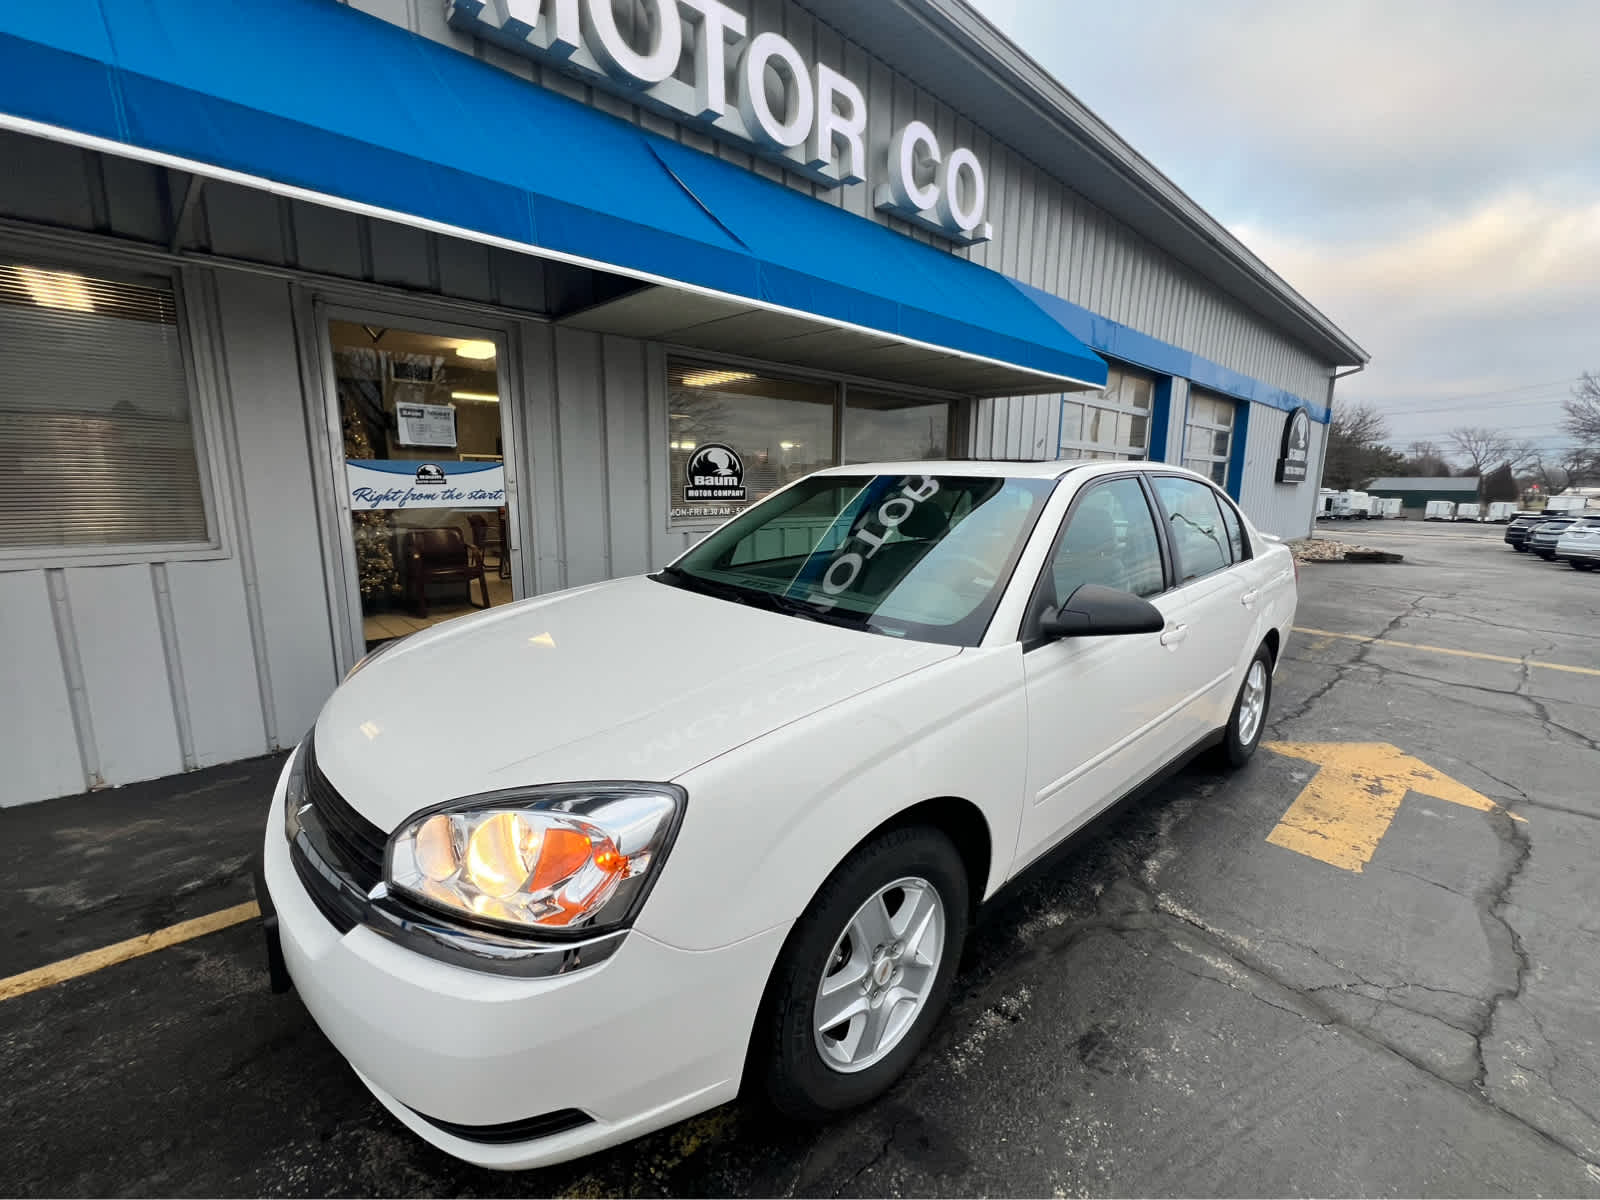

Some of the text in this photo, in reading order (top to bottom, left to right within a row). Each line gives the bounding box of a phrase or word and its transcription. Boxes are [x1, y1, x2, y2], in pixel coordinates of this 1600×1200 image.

[898, 120, 993, 241] CO.
[352, 487, 401, 508] Right
[398, 487, 438, 508] from
[441, 487, 465, 500] the
[688, 489, 744, 497] MOTOR COMPANY
